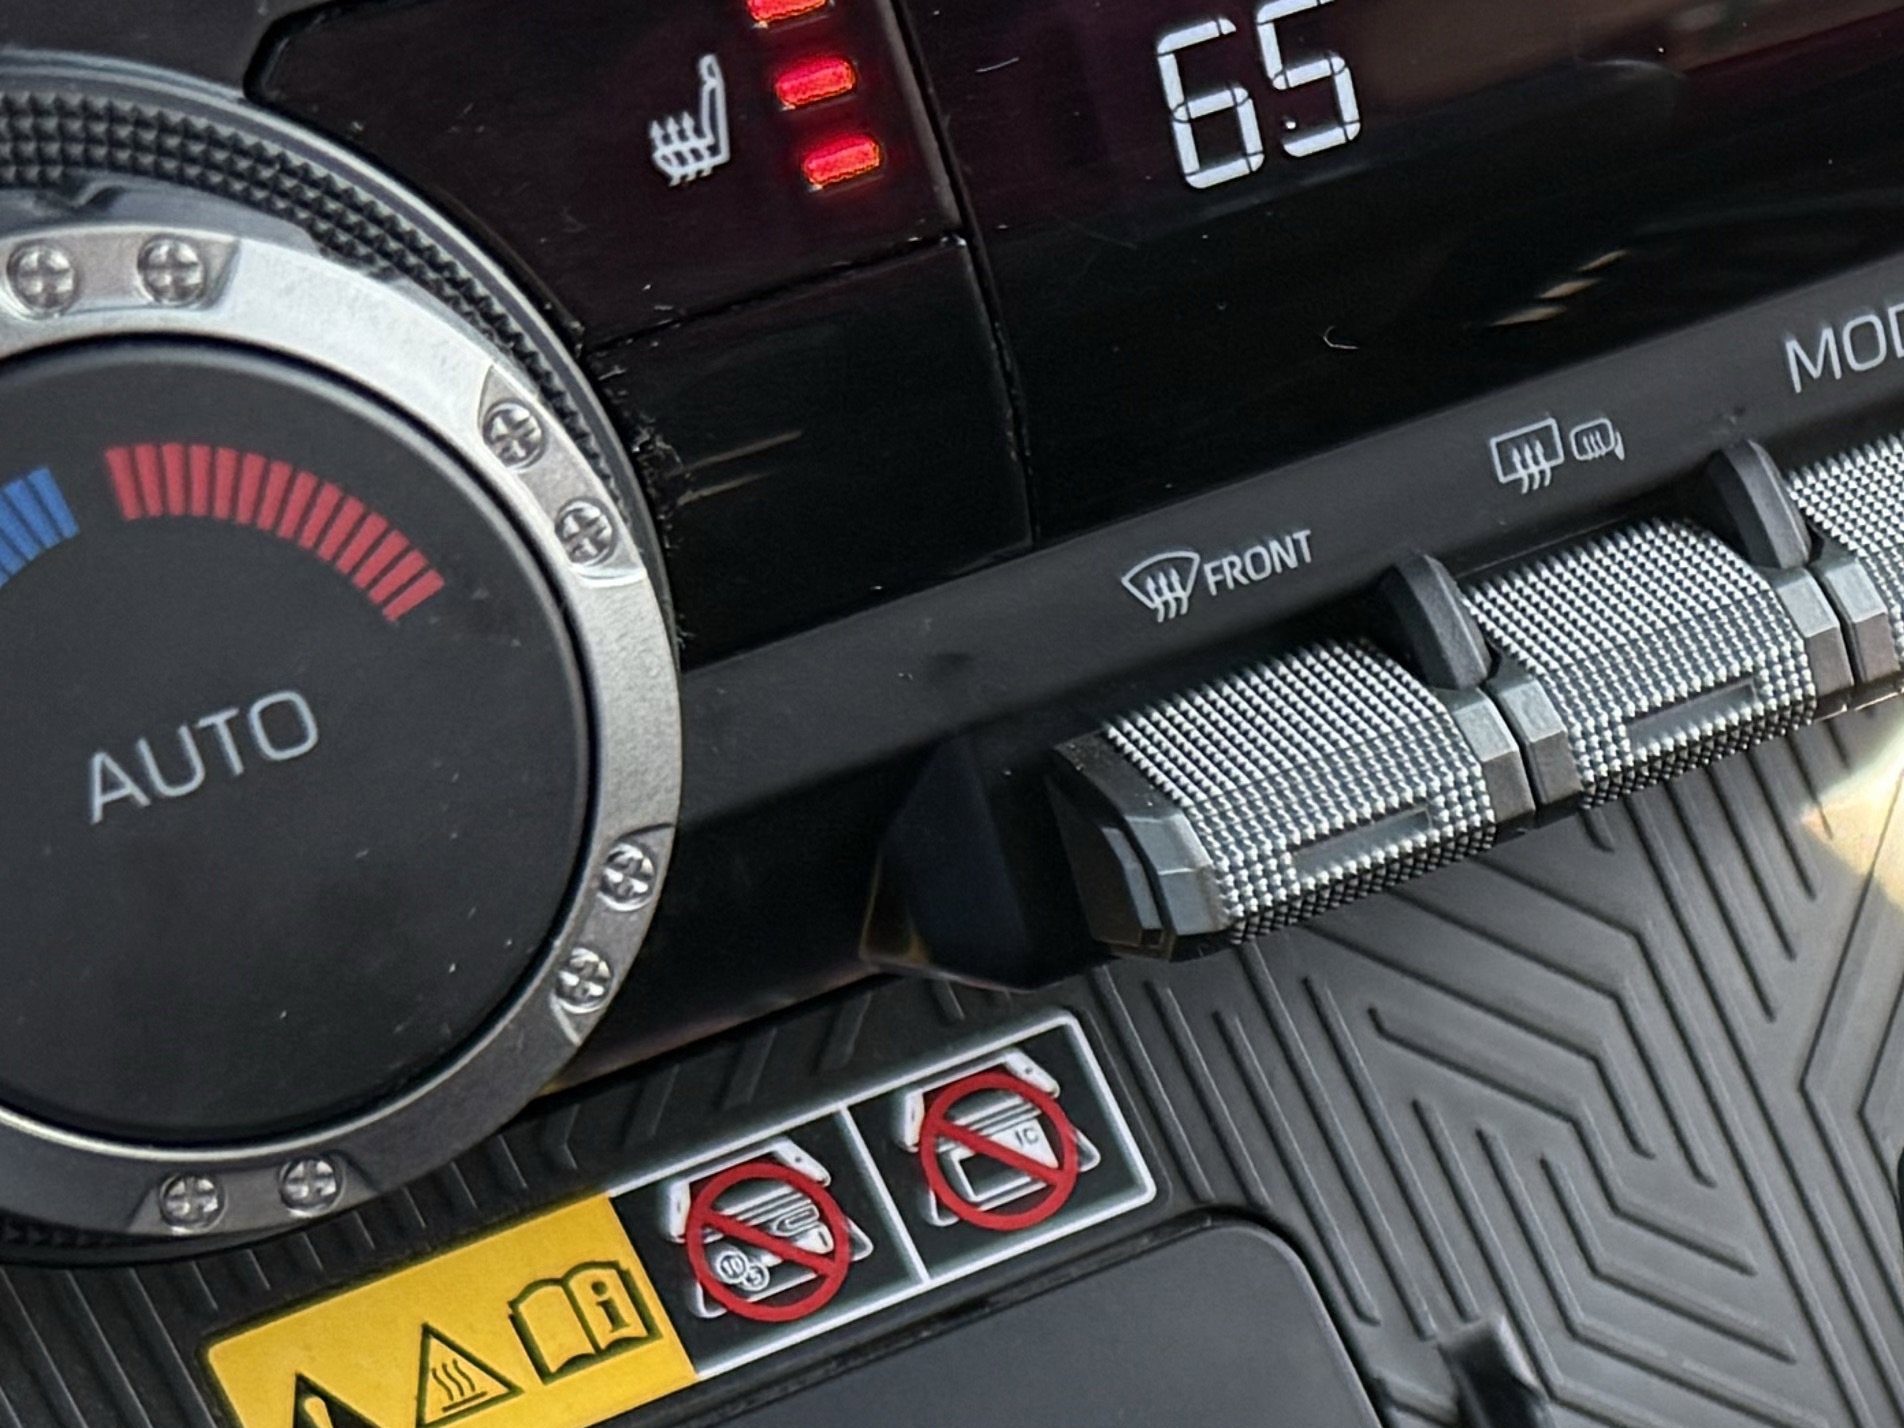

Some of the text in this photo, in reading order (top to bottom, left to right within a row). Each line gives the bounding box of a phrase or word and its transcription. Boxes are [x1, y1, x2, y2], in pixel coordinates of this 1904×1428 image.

[1156, 0, 1361, 189] 65
[1203, 529, 1312, 597] FRONT
[89, 690, 319, 825] AUTO
